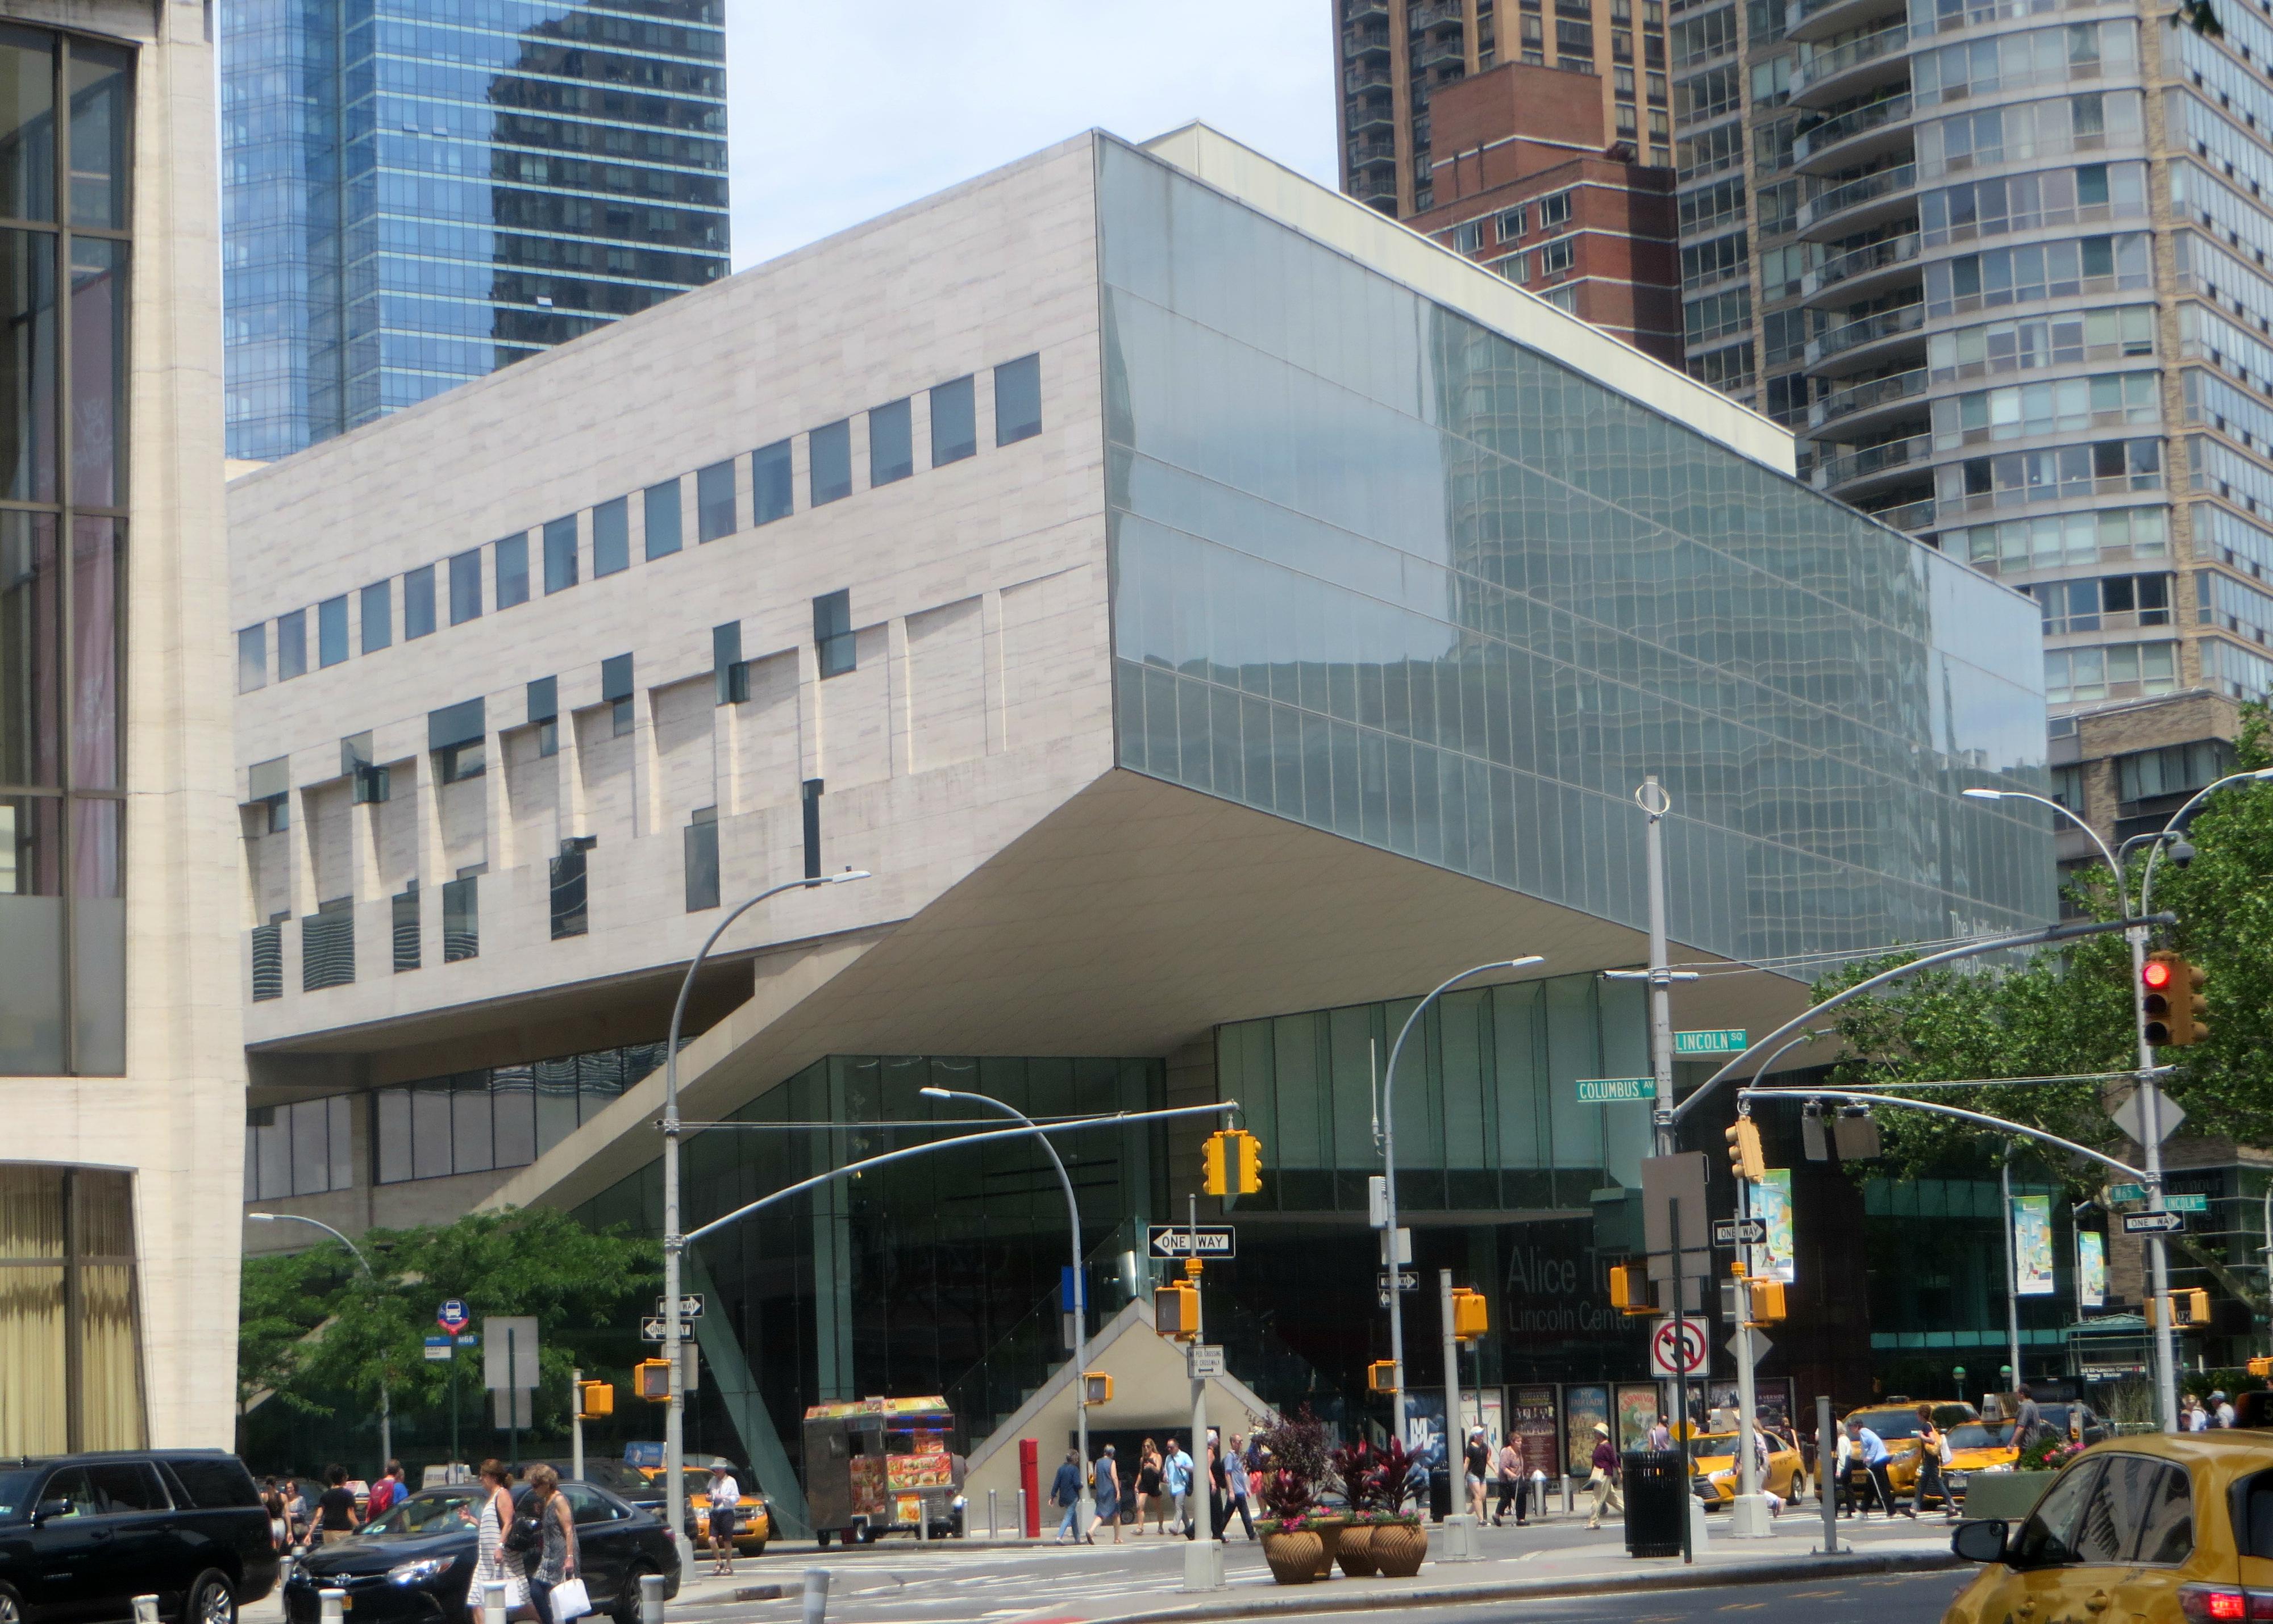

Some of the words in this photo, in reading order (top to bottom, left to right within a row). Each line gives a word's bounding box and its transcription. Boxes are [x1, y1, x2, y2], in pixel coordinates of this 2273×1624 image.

[1676, 1033, 1728, 1051] LINCOLN
[1580, 1081, 1639, 1099] COLUMBUS
[2163, 1197, 2196, 1210] LINCOLN
[2132, 1218, 2149, 1227] ONE
[2157, 1217, 2175, 1226] WAY
[1721, 1228, 1735, 1238] ONE
[1743, 1226, 1758, 1237] WAY
[1162, 1236, 1186, 1248] ONE
[1197, 1236, 1222, 1248] WAY
[1506, 1245, 1577, 1294] Alice
[682, 1302, 696, 1310] WAY
[1509, 1303, 1574, 1332] Lincoln
[1579, 1300, 1637, 1331] Center
[650, 1325, 664, 1334] ONE
